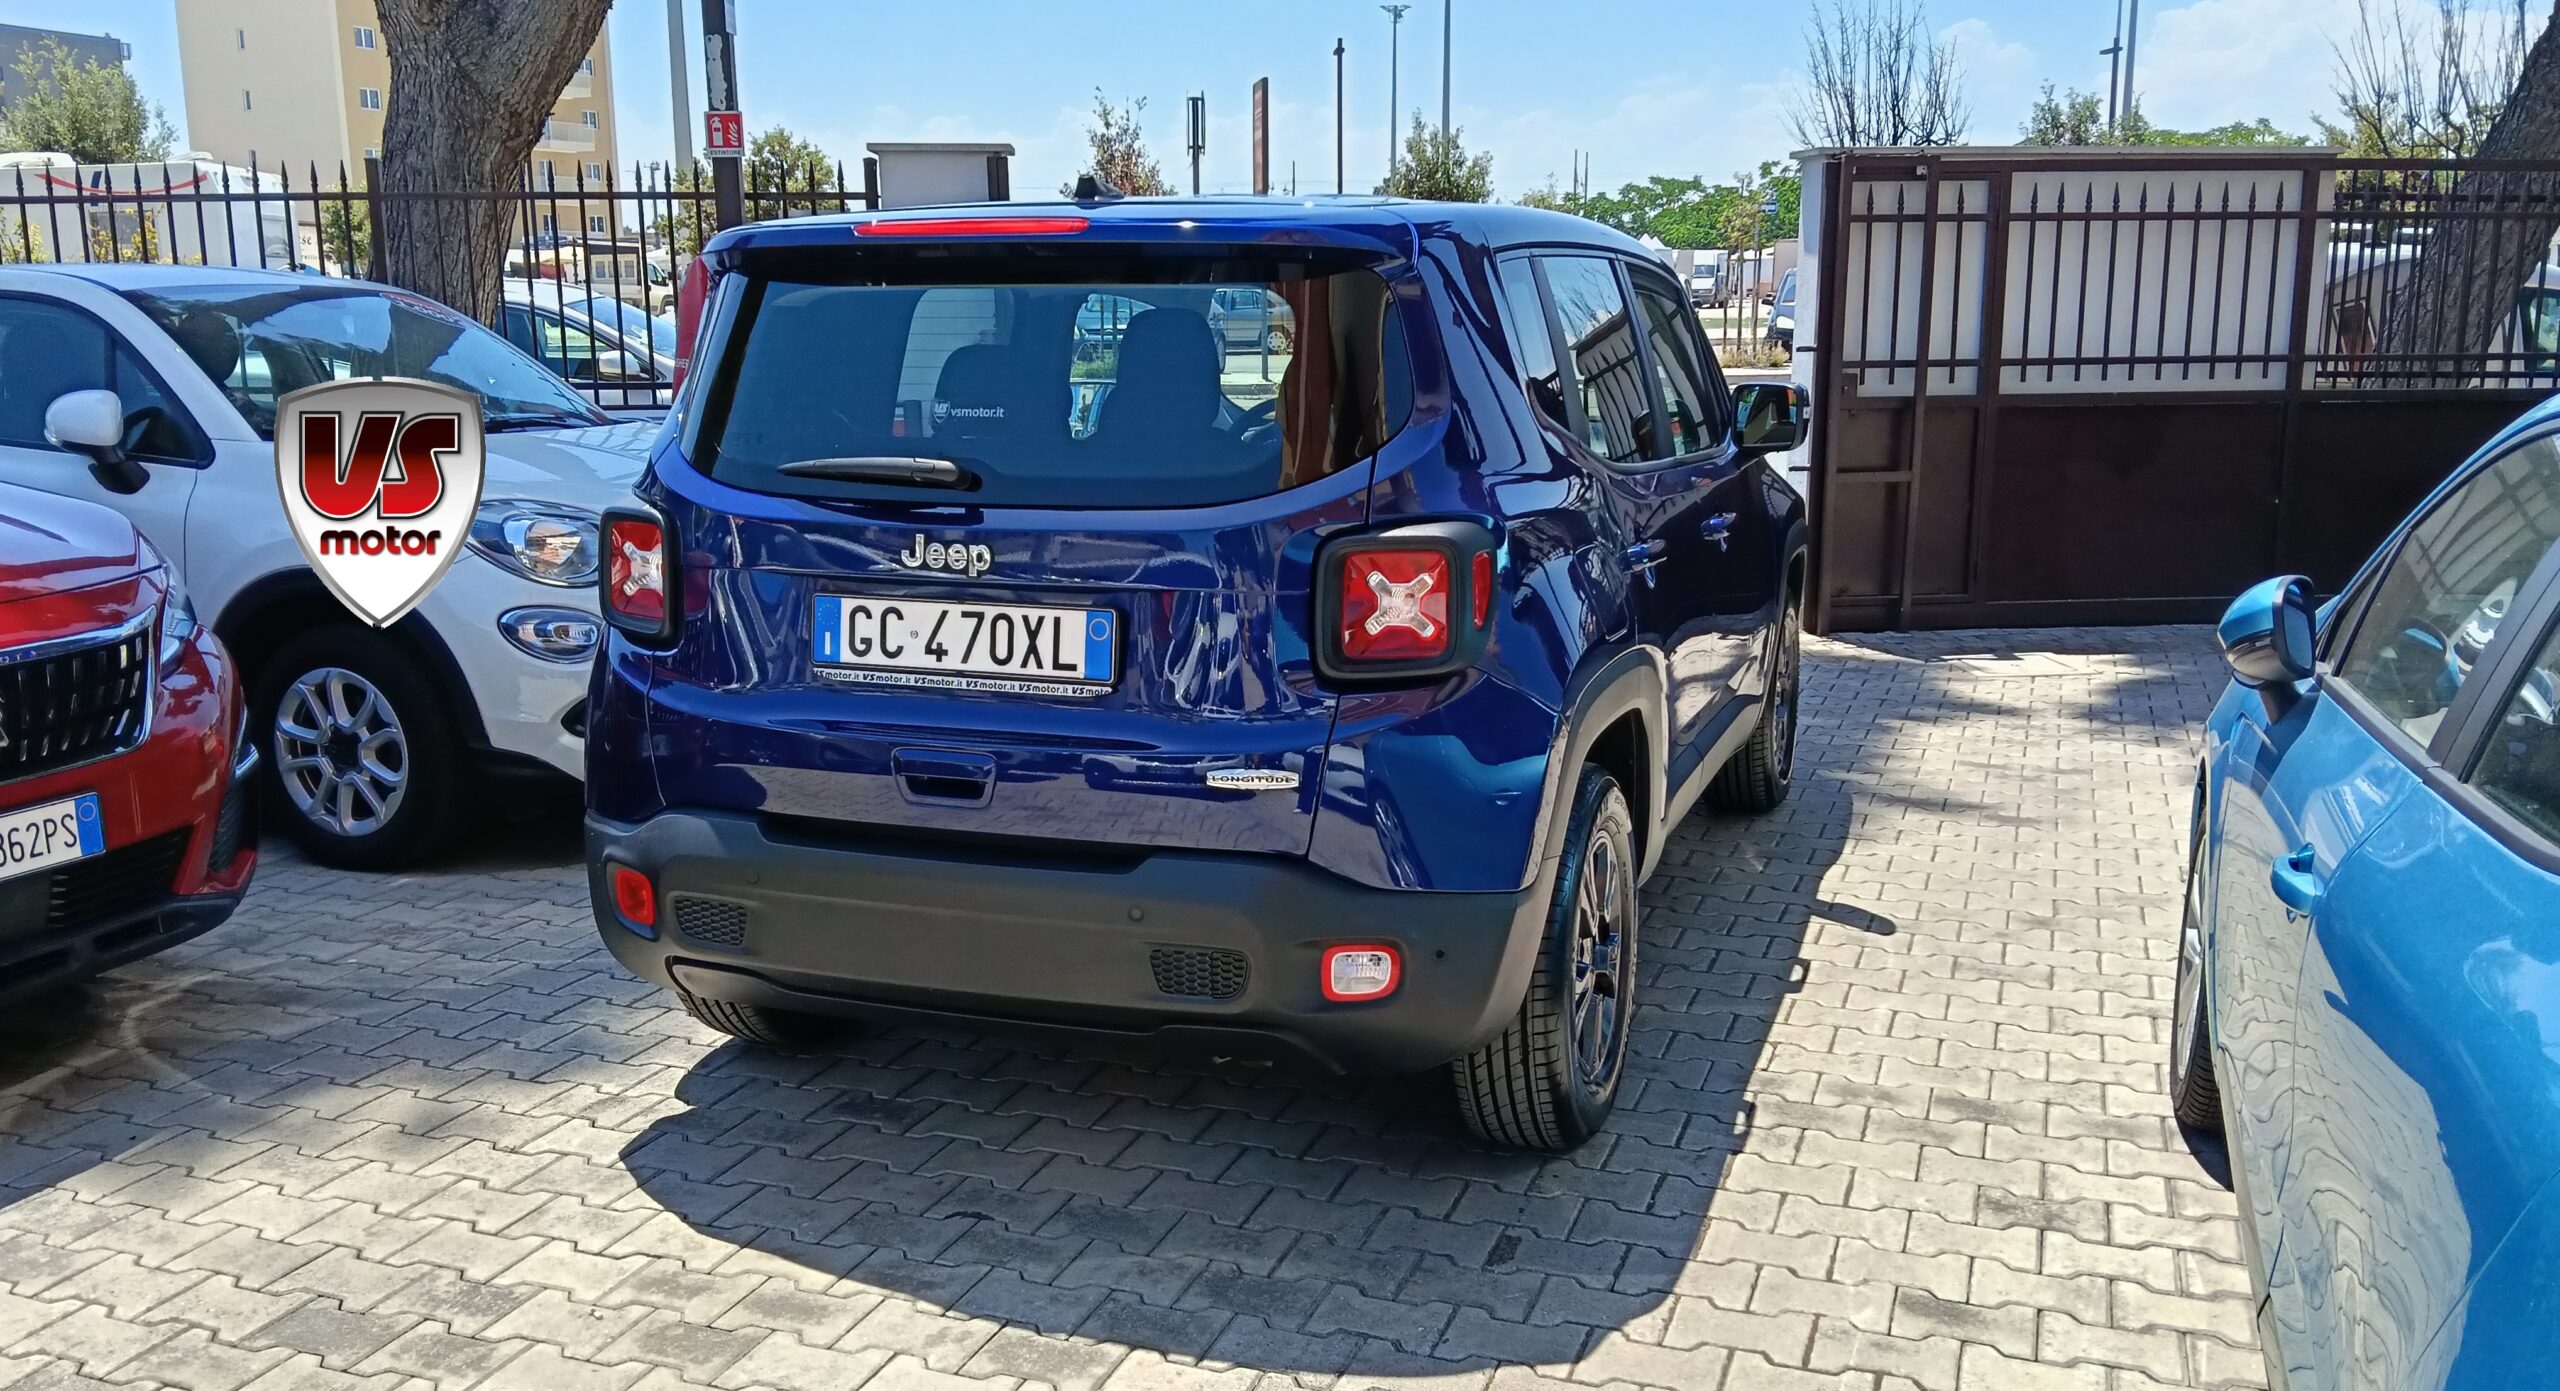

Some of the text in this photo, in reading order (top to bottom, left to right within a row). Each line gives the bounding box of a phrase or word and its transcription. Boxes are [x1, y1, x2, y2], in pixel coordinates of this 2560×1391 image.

[950, 406, 1005, 418] vsmotor.it
[900, 533, 991, 577] Jeep
[849, 605, 1078, 671] GC 470XL
[862, 673, 911, 684] VSmotor.it
[914, 676, 963, 688] VSmotor.it
[965, 680, 1016, 691] VSmotor.it
[1018, 683, 1069, 694] VSmotor.it
[1208, 775, 1296, 784] LONGITUDE
